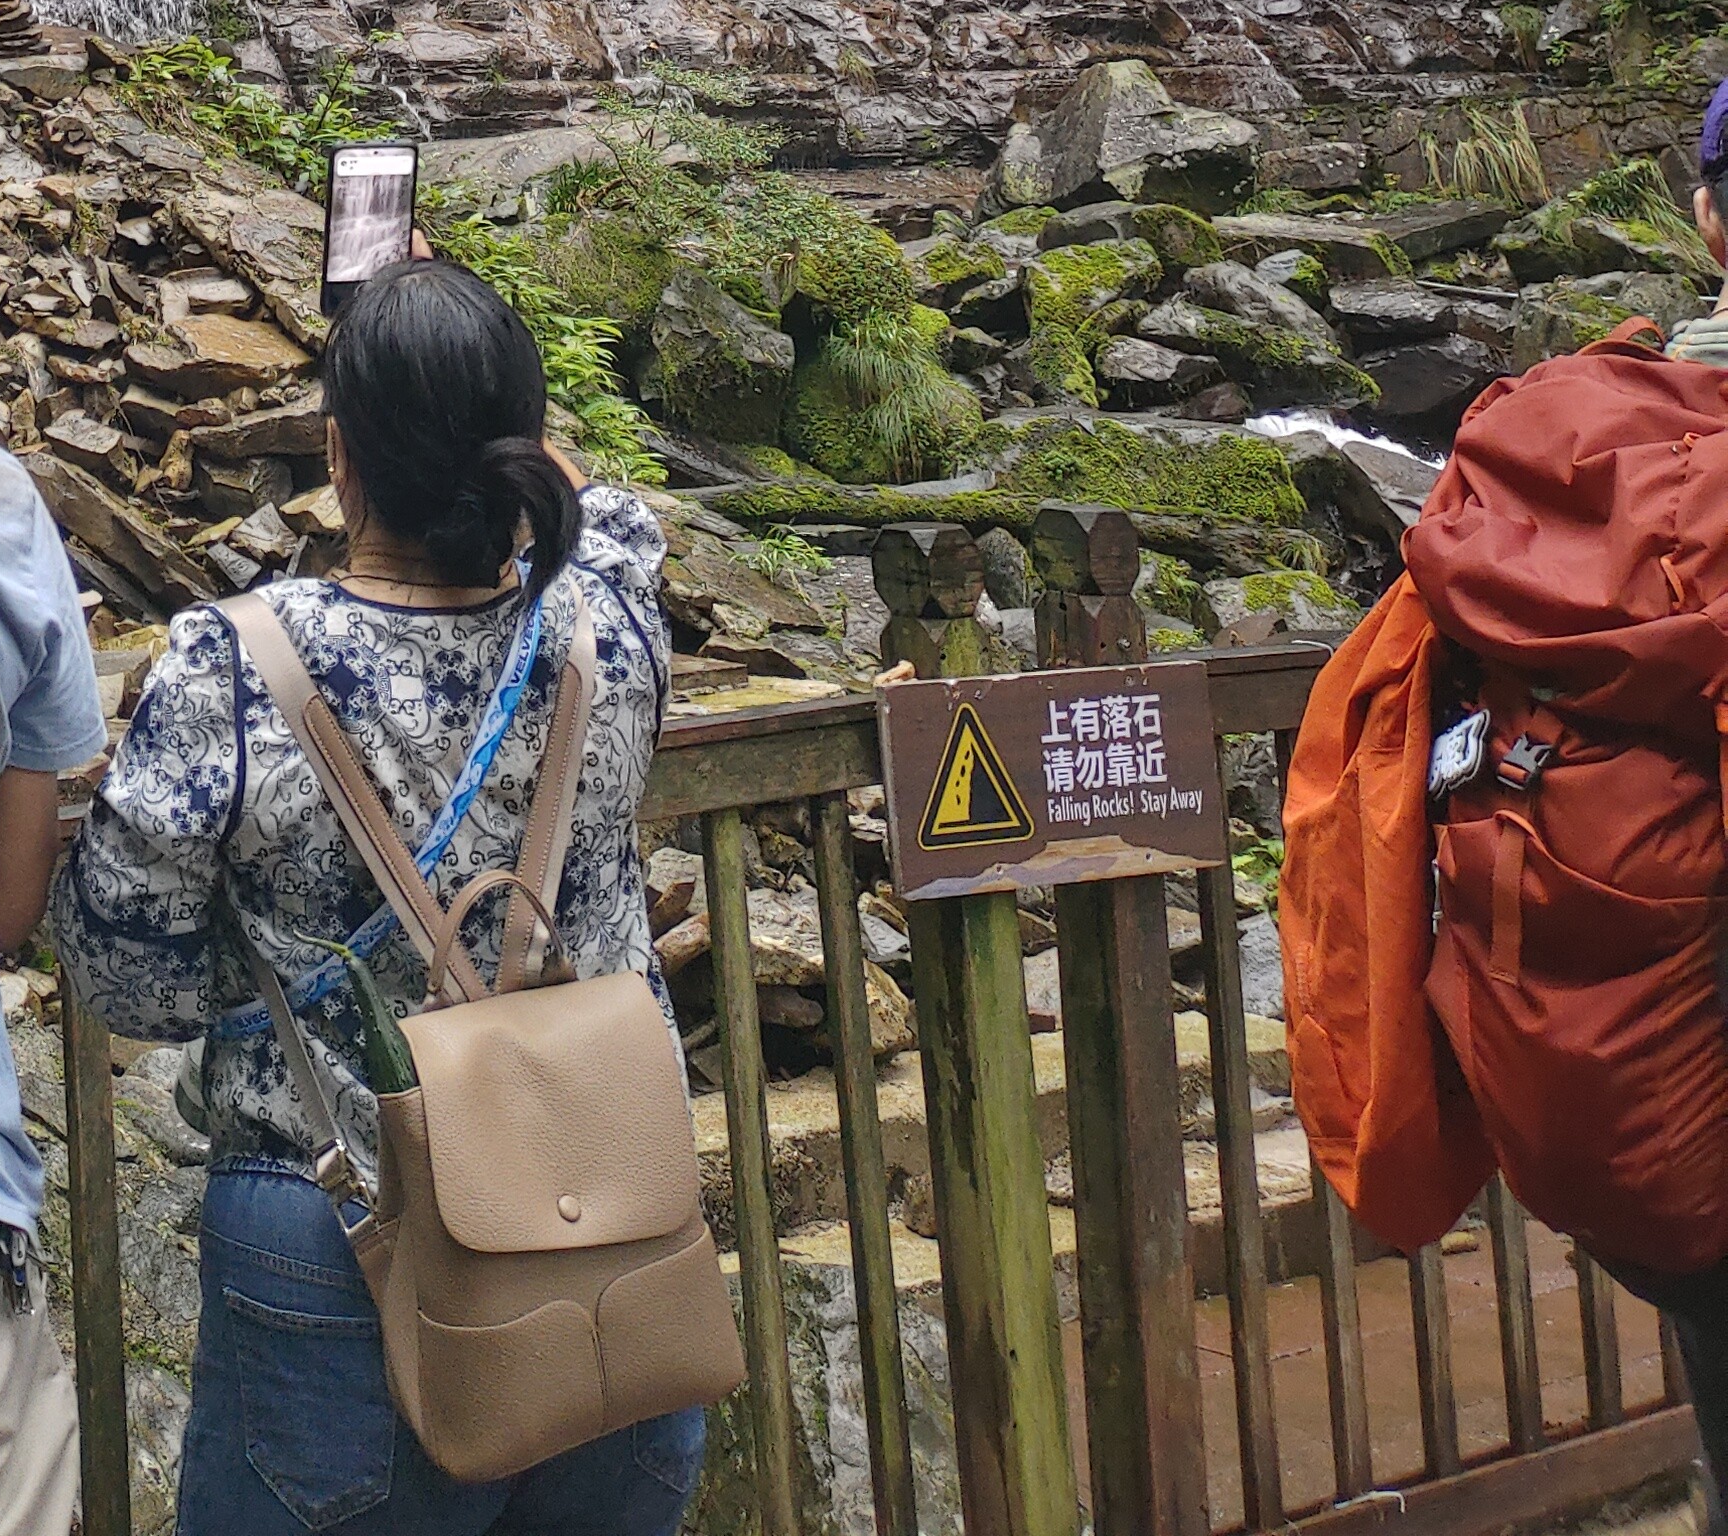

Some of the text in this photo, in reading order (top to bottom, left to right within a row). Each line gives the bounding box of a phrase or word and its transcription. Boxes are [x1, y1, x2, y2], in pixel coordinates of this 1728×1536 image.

[1040, 694, 1161, 744] 上有落石
[1042, 739, 1168, 793] 请勿靠近
[1047, 787, 1203, 827] Falling Rocks! Stay Away
